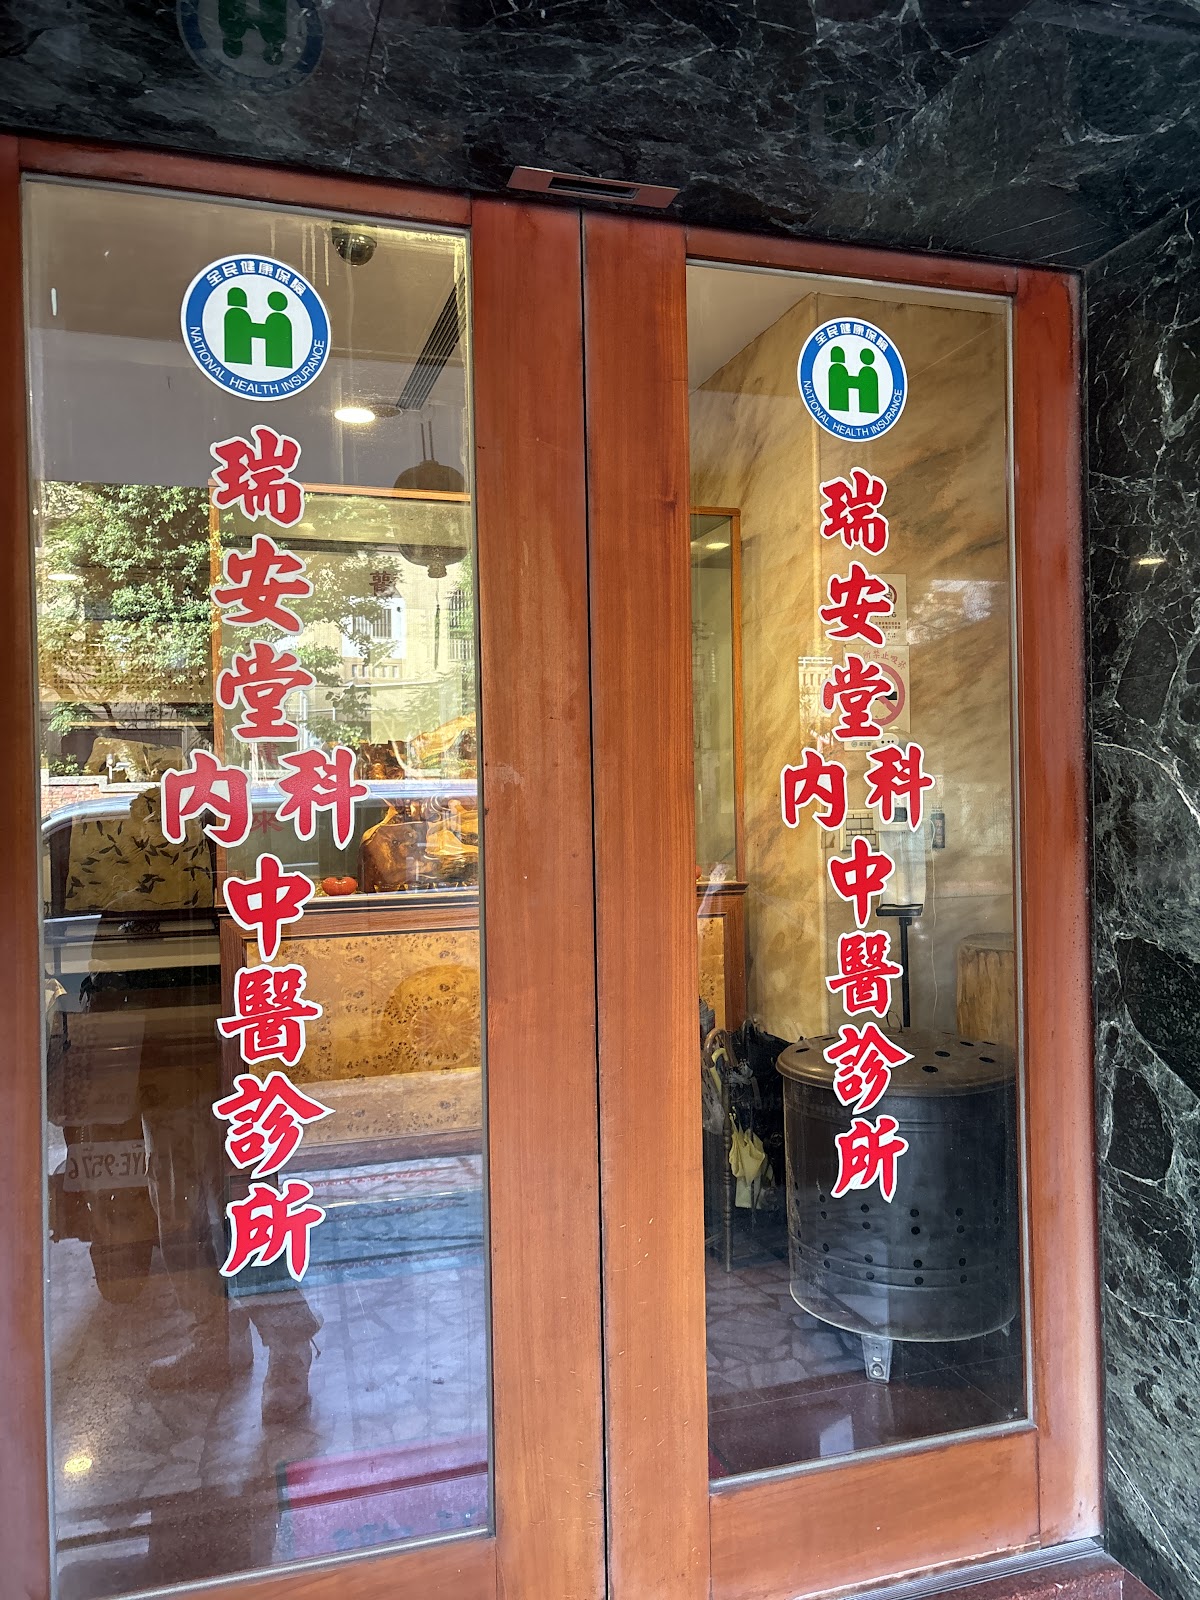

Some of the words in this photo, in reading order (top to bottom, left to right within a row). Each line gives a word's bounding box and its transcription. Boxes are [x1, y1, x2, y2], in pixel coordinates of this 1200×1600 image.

[189, 326, 225, 382] NATIONAL
[229, 376, 280, 395] HEALTH
[280, 339, 325, 393] INSURANCE
[803, 380, 830, 426] NATIONAL
[832, 422, 869, 437] HEALTH
[870, 388, 903, 434] INSURANCE
